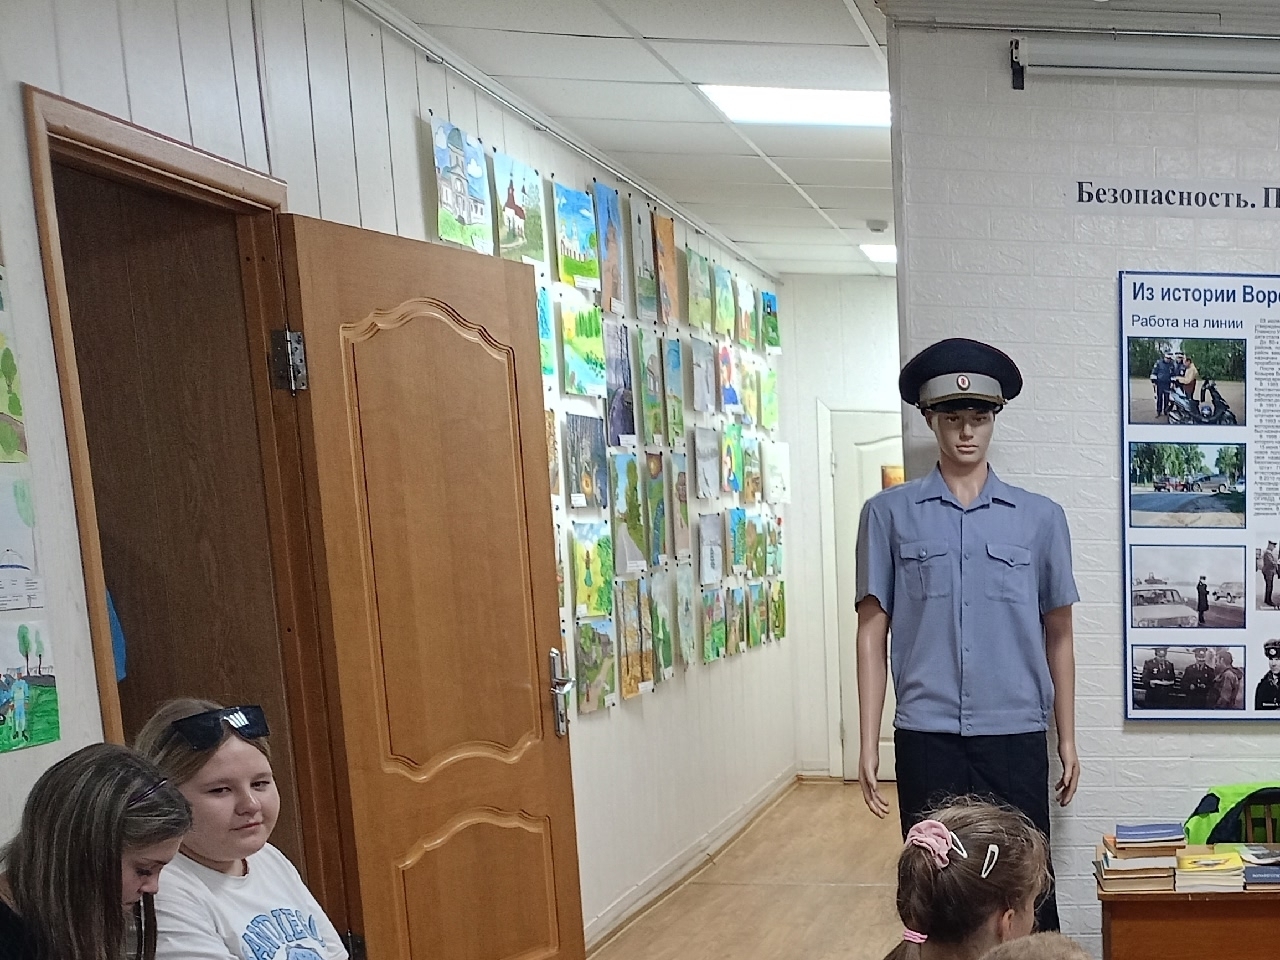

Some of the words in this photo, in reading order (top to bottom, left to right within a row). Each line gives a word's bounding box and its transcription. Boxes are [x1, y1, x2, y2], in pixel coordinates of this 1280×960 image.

[1076, 181, 1256, 209] Безопасность.
[1132, 282, 1154, 301] Из
[1161, 286, 1236, 307] истории
[1131, 314, 1179, 328] Работа
[1183, 318, 1199, 328] на
[1203, 318, 1243, 329] линии
